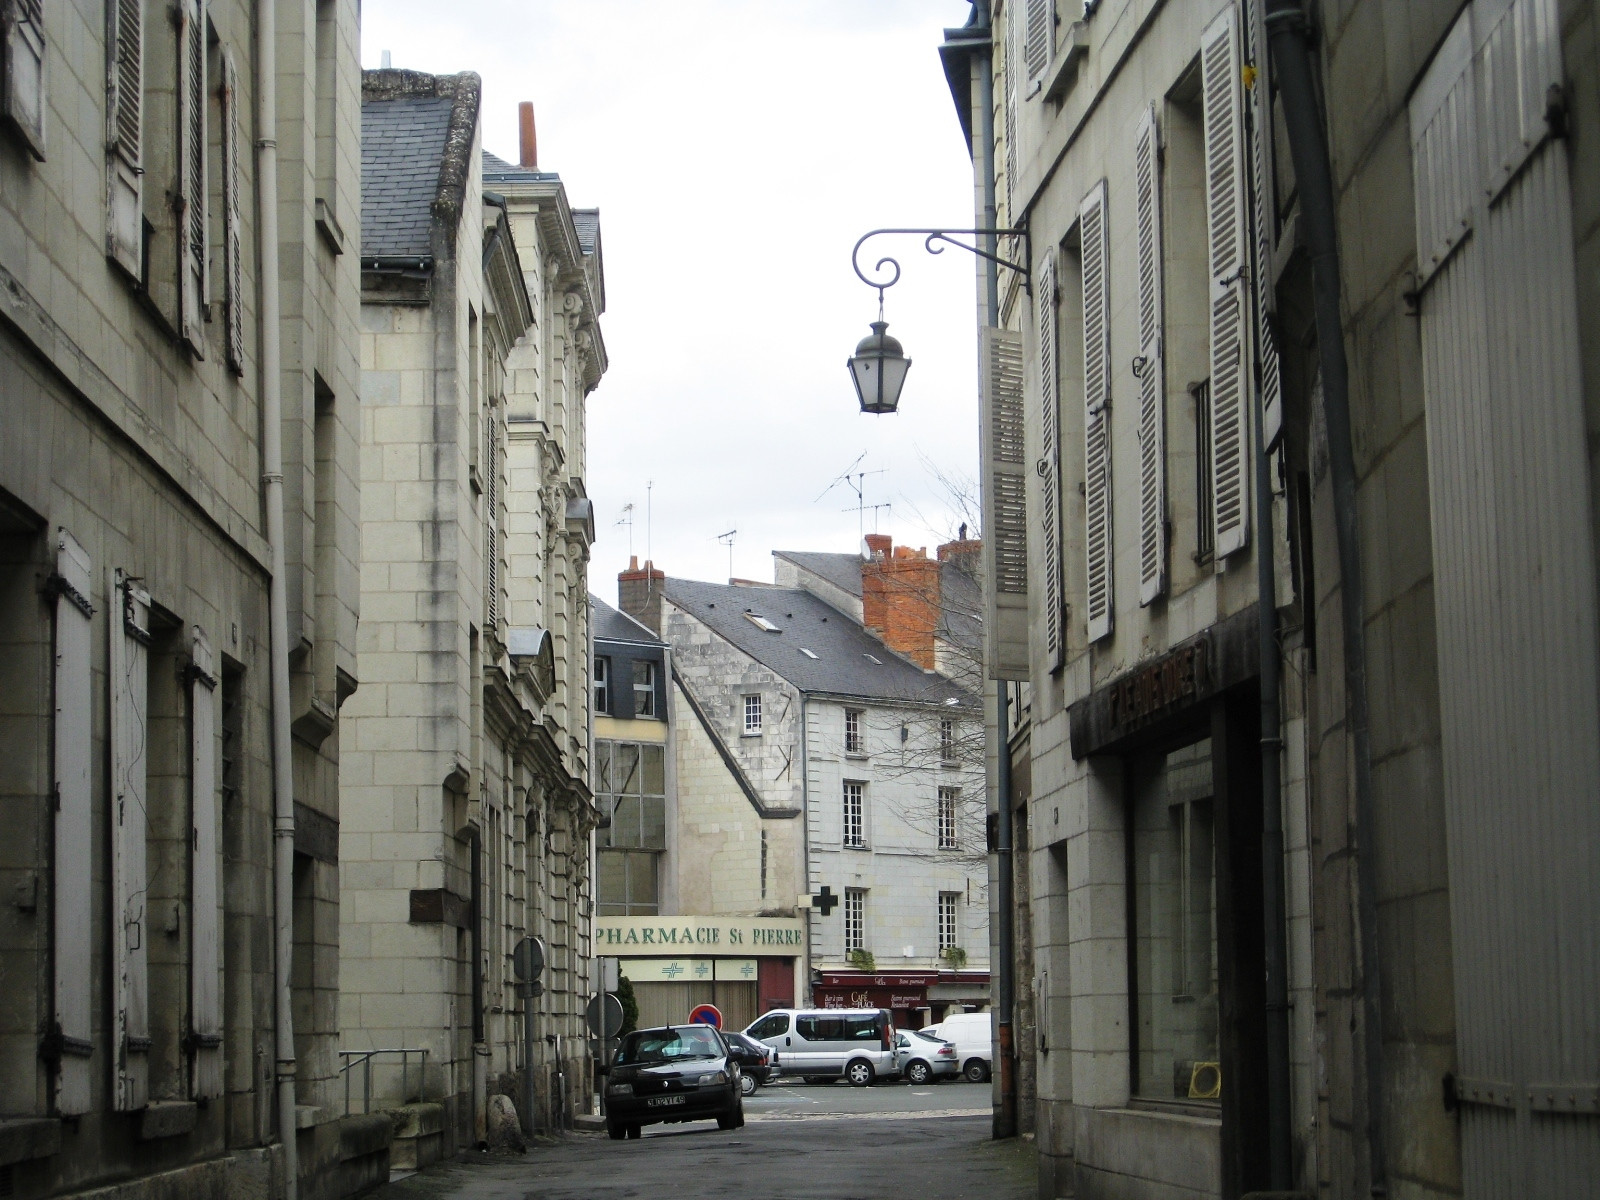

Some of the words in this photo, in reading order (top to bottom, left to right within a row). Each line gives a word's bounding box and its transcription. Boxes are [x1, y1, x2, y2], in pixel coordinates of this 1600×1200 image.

[595, 927, 719, 944] PHARMACIE
[729, 927, 743, 944] St
[753, 928, 802, 944] PIERRE
